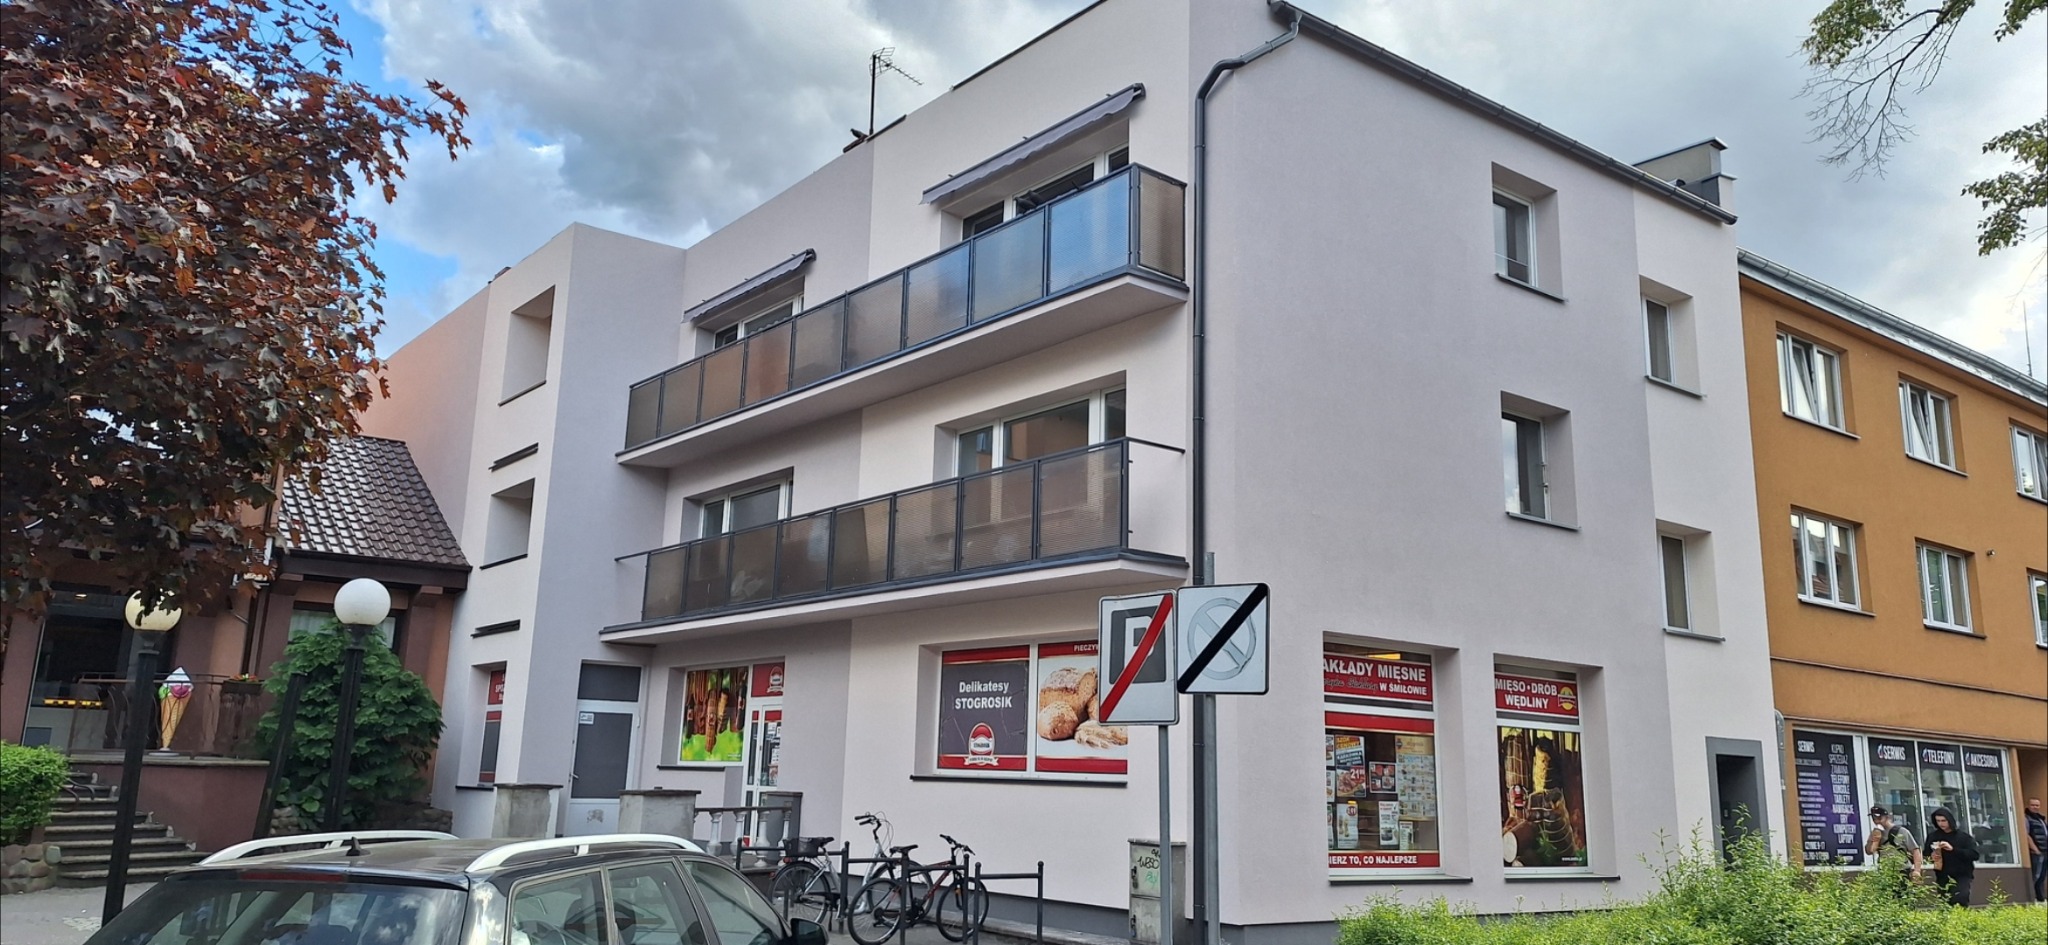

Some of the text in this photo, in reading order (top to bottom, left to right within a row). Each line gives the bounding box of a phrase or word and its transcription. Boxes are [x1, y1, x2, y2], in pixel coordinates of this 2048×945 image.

[1377, 664, 1427, 683] MIĘSNE
[959, 681, 1010, 694] Delikatesy
[1380, 682, 1387, 692] W
[1389, 682, 1428, 696] ŚMIŁOWIE
[1495, 678, 1557, 696] MIĘSO DRÓB
[954, 696, 1013, 710] STOGROSIK
[1504, 693, 1549, 710] WĘDLINY
[1882, 745, 1906, 760] SERWIS
[1927, 750, 1955, 765] TELEFONY
[1970, 754, 1999, 768] AKCESORIA
[1363, 856, 1375, 864] CO
[1376, 855, 1417, 864] NAJLEPSZE
